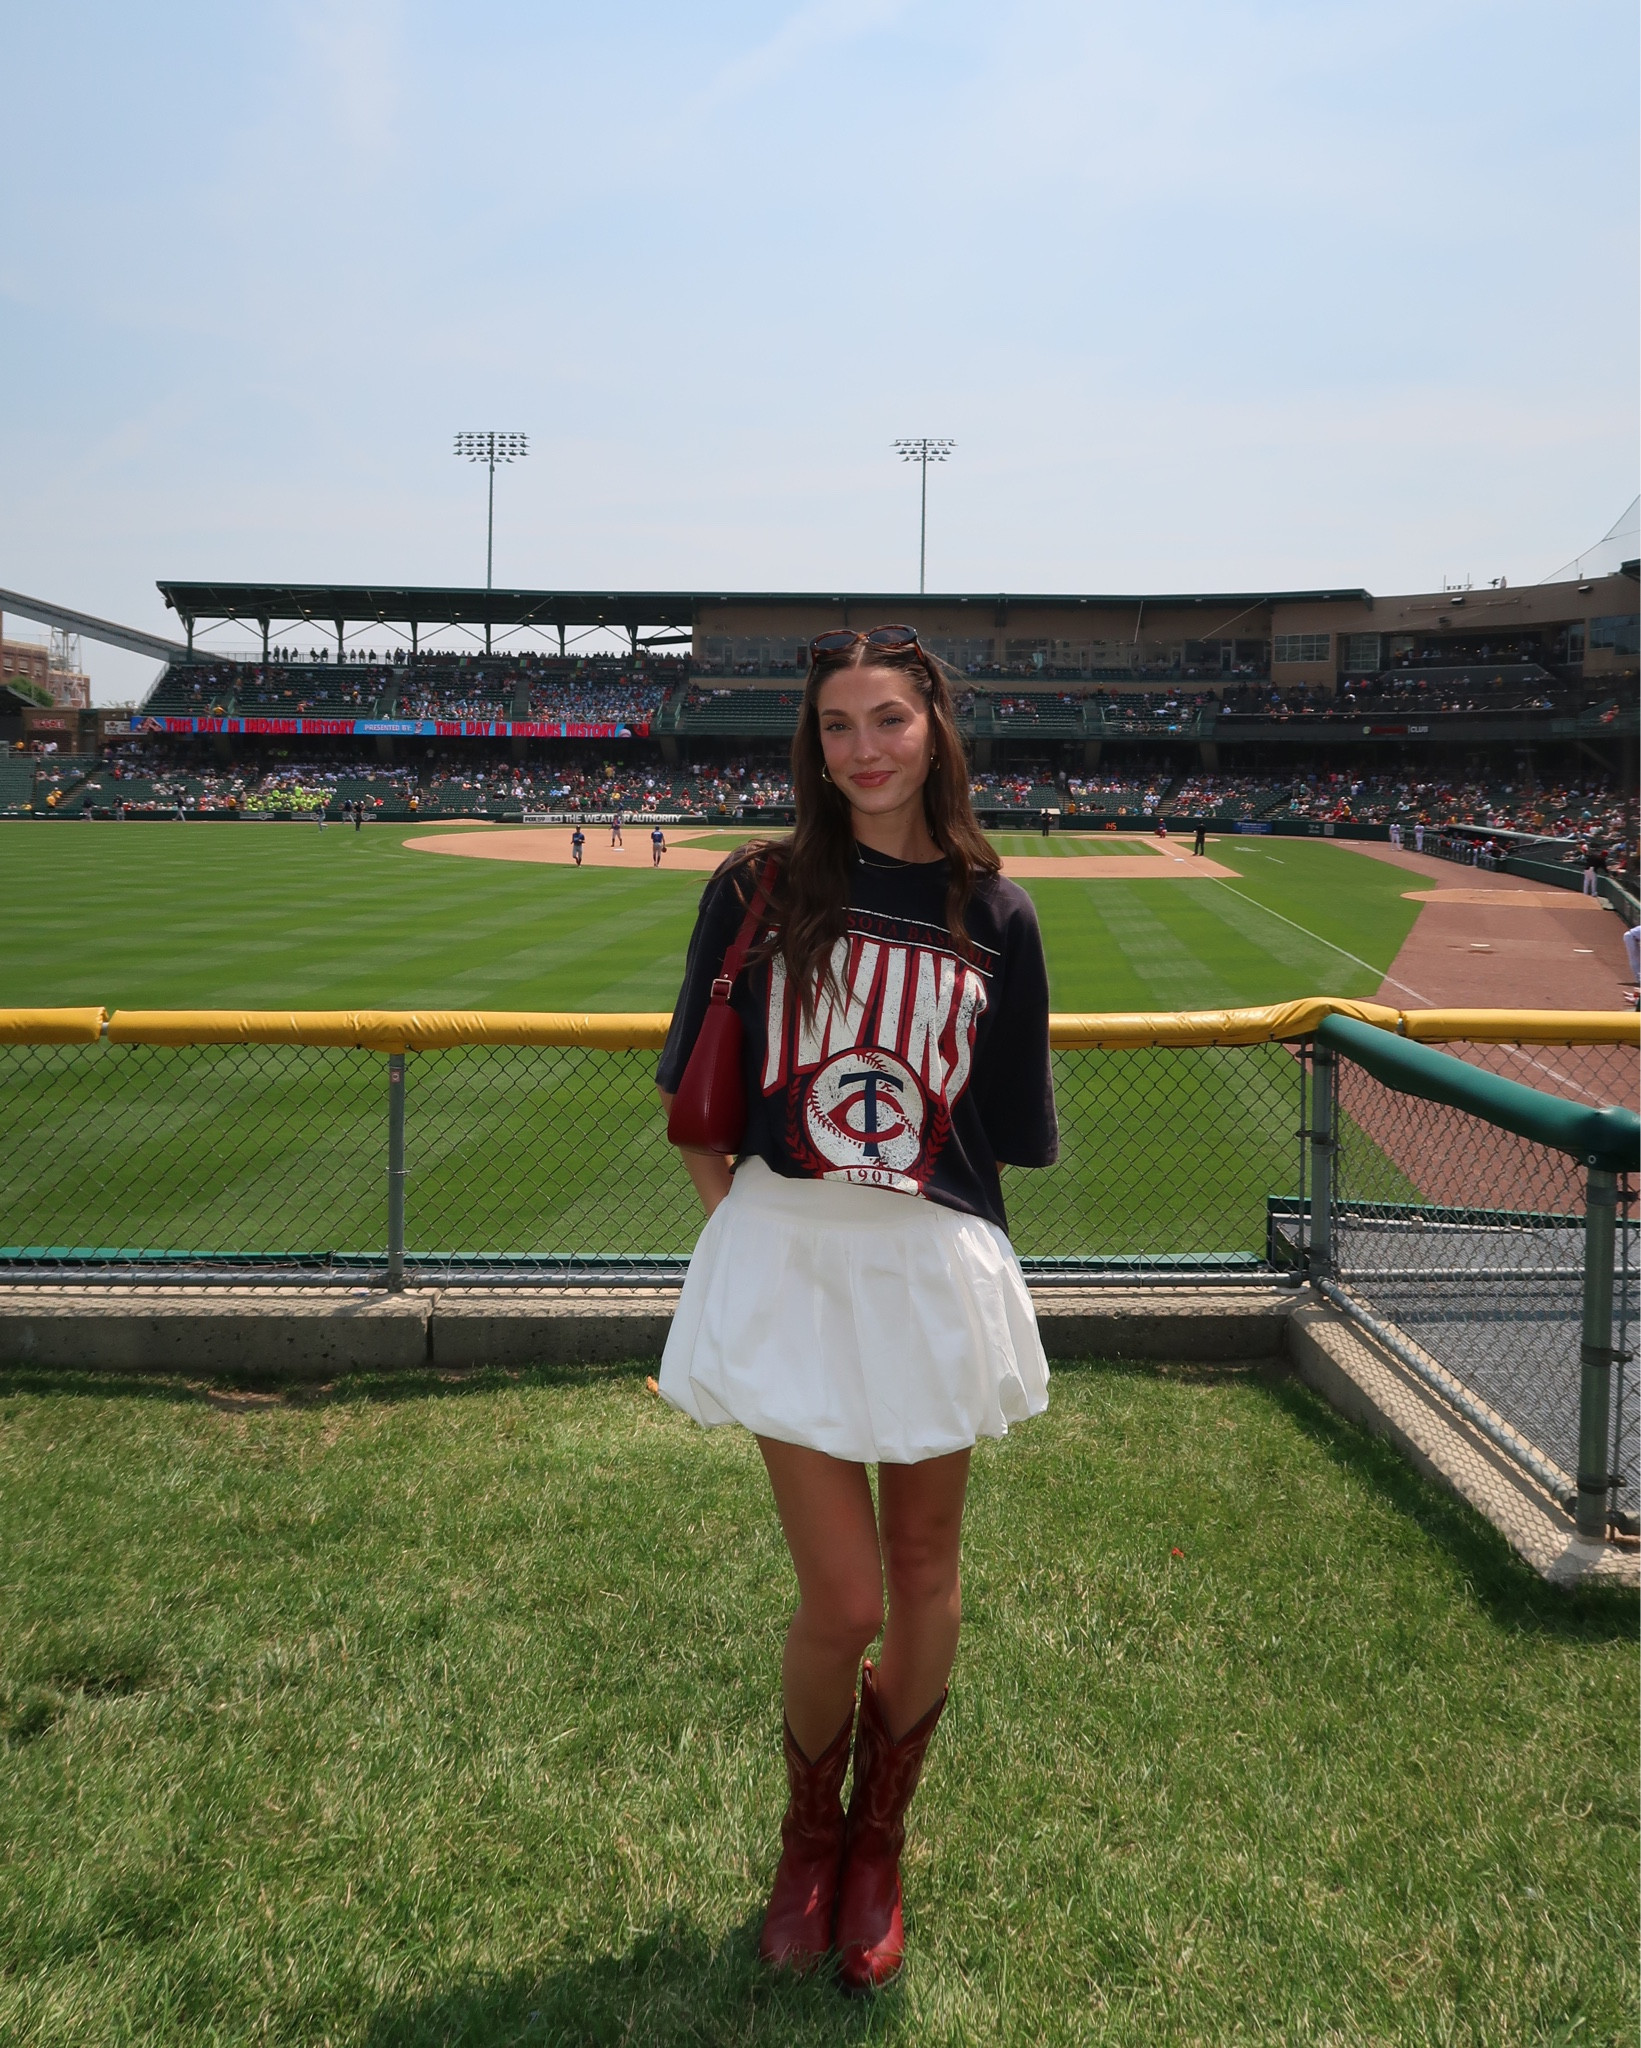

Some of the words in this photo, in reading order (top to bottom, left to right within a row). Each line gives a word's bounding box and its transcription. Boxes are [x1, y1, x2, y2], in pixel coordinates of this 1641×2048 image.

[165, 717, 192, 732] THIS
[198, 717, 223, 732] DAY
[244, 717, 297, 733] INDIANS
[302, 719, 356, 734] HISTORY
[435, 721, 461, 735] THIS
[466, 721, 491, 735] DAY
[512, 722, 561, 736] INDIANS
[566, 722, 617, 737] HISTORY
[564, 814, 582, 823] THE
[631, 814, 682, 823] AUTHORITY
[846, 1167, 895, 1185] 1901
